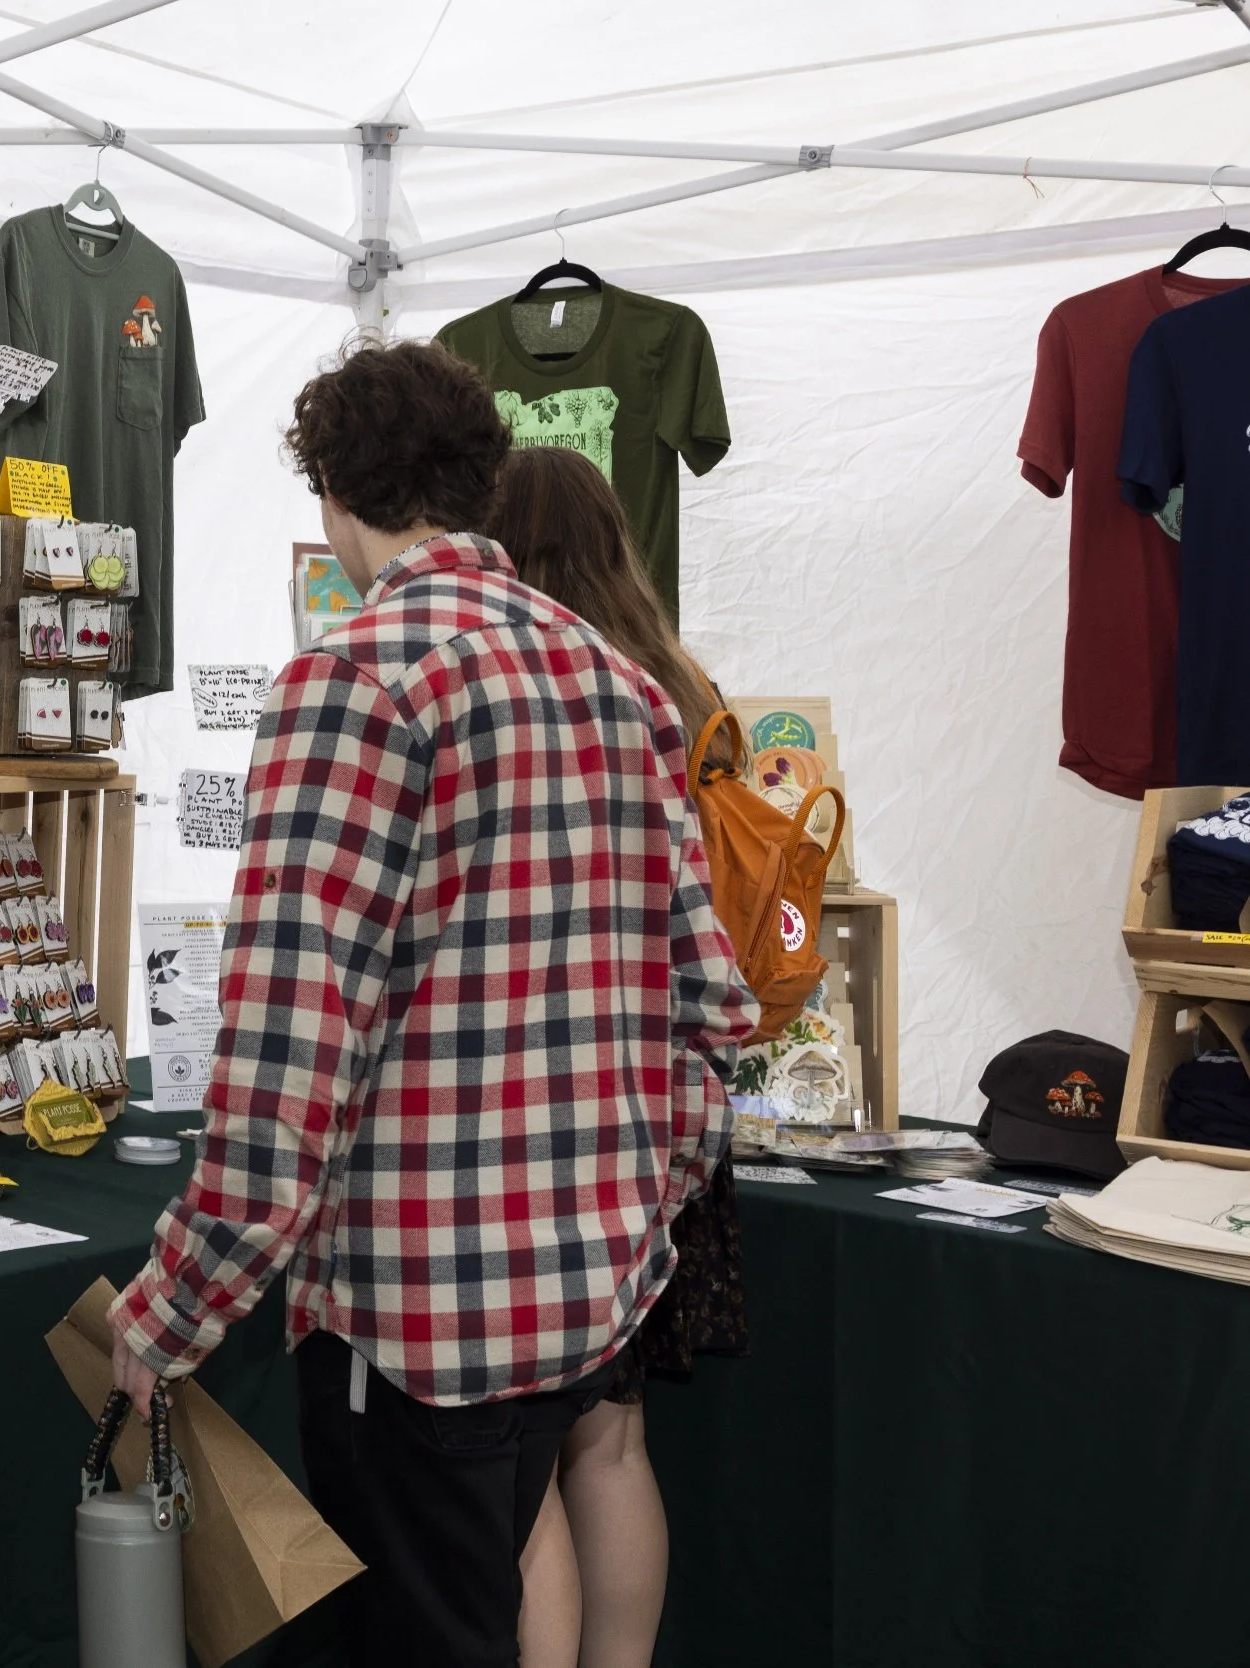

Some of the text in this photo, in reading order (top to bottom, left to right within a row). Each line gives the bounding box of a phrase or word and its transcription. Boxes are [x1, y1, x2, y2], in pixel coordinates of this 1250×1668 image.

[10, 460, 58, 475] 50% OFF
[196, 774, 236, 797] 25%
[188, 795, 222, 804] PLANT
[186, 804, 243, 816] SUSTAINABLE
[196, 832, 211, 842] BUY
[43, 1103, 82, 1118] PLANT POSSE
